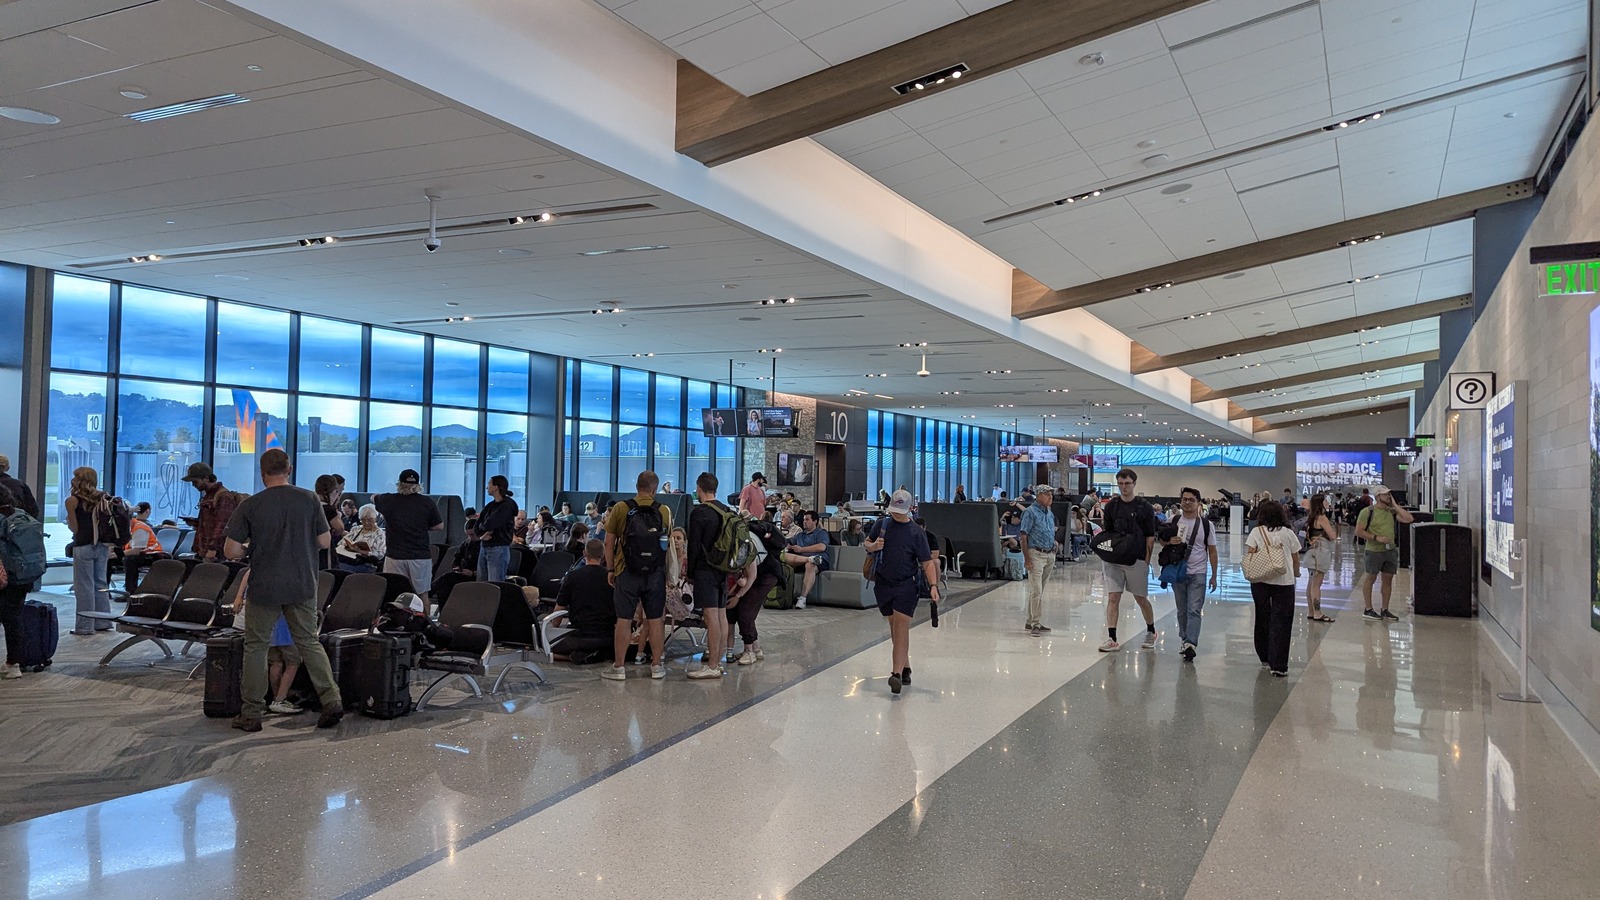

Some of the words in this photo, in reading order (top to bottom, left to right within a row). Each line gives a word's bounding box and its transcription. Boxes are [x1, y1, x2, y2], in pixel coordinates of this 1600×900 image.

[1546, 262, 1600, 295] EXIT
[90, 415, 99, 431] 10
[831, 411, 849, 441] 10
[580, 441, 590, 451] 12
[1302, 462, 1335, 474] MORE
[1338, 463, 1377, 474] SPACE
[1302, 474, 1312, 484] IS
[1315, 474, 1328, 484] ON
[1329, 475, 1350, 485] THE
[1302, 486, 1314, 495] AT
